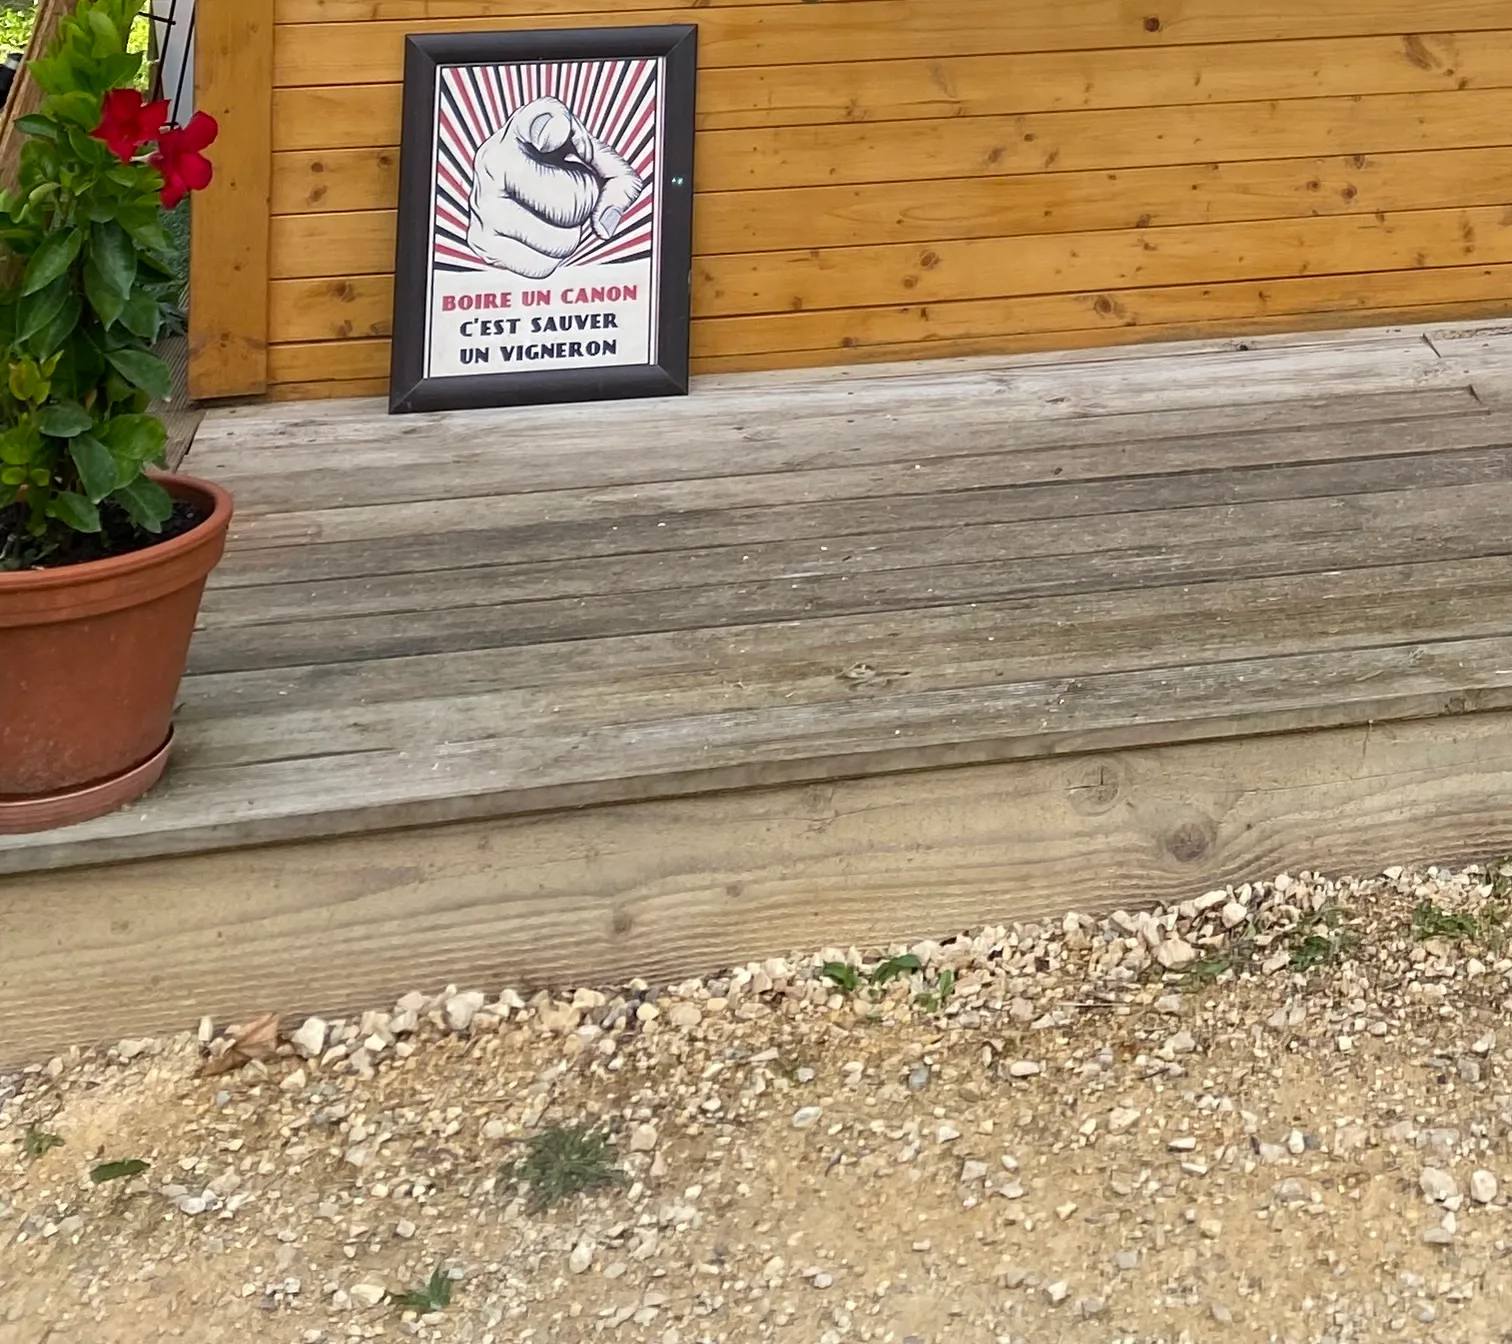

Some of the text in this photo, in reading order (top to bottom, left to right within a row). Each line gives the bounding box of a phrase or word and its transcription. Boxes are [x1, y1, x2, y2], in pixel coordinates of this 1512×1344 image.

[442, 284, 638, 312] BOIRE UN CANON
[460, 312, 619, 337] C'EST SAUVER
[460, 339, 617, 365] UN VIGNERON
